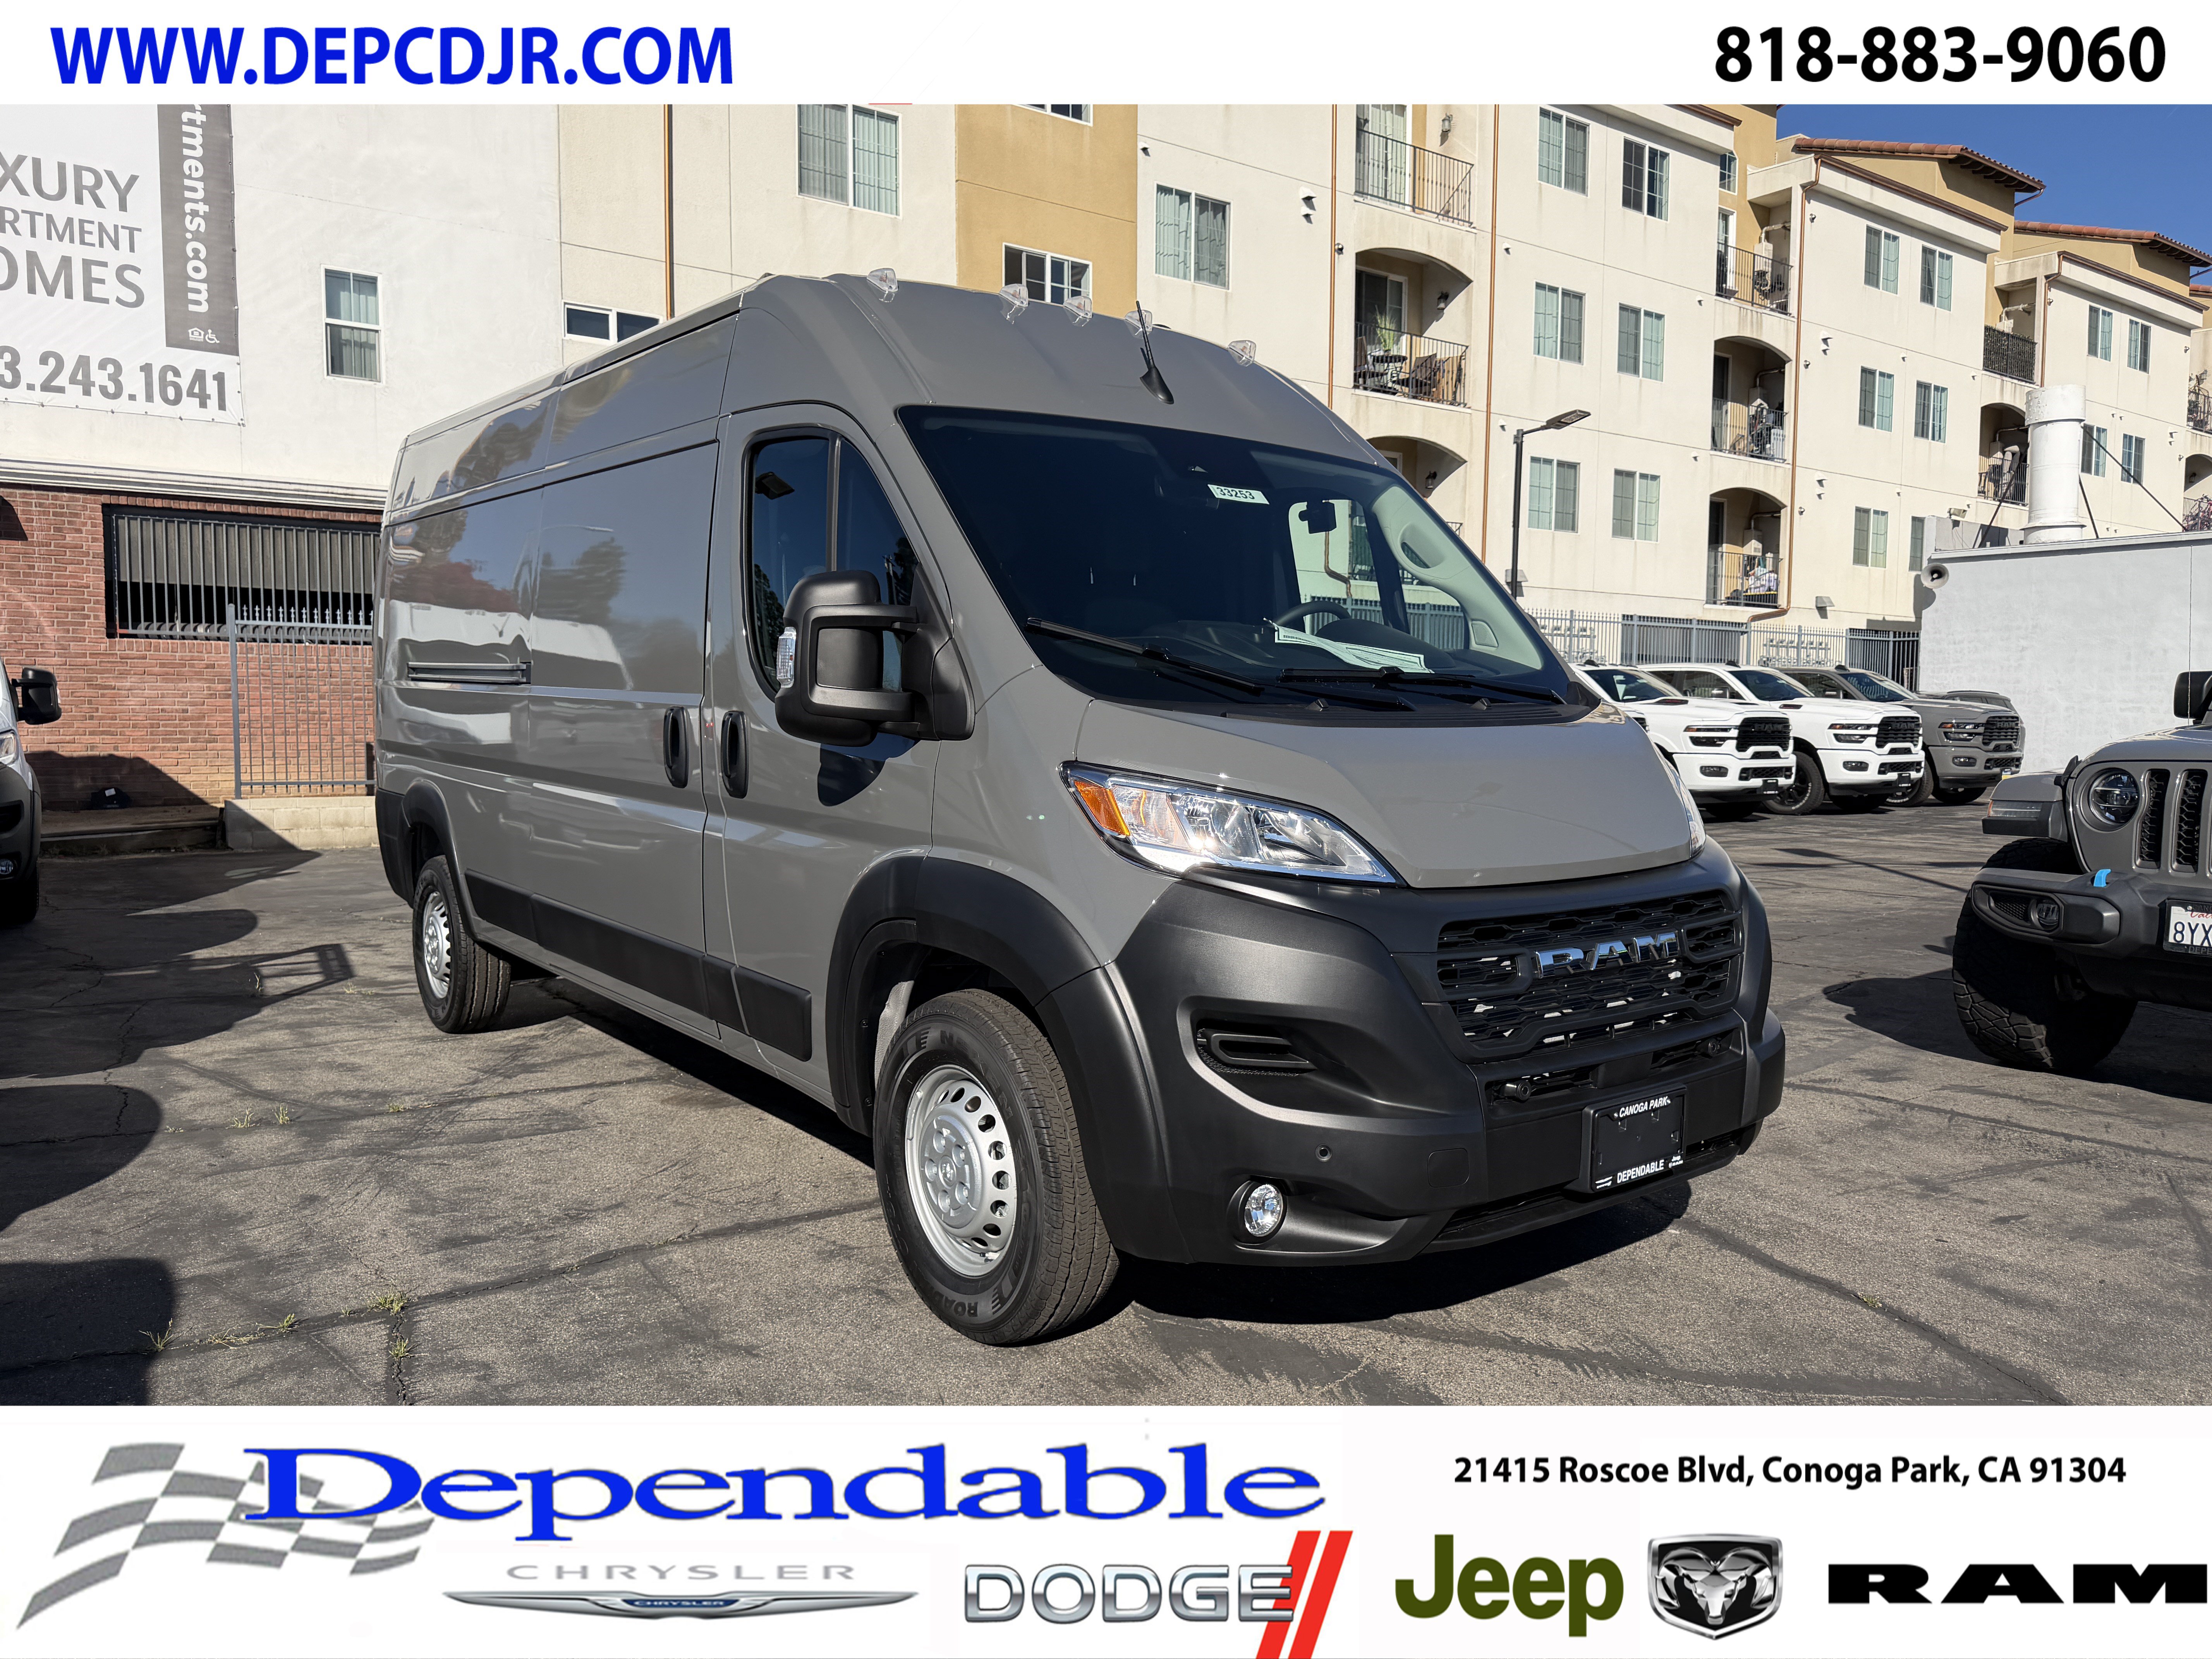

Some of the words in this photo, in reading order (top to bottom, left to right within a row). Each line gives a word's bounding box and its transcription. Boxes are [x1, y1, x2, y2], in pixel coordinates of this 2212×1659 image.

[0, 206, 142, 253] RTMENT
[1216, 487, 1255, 500] 33253
[1534, 931, 1679, 979] RAM
[1619, 1102, 1648, 1118] CANOGA
[1649, 1096, 1668, 1109] PARK
[1617, 1160, 1664, 1183] DEPENDABLE
